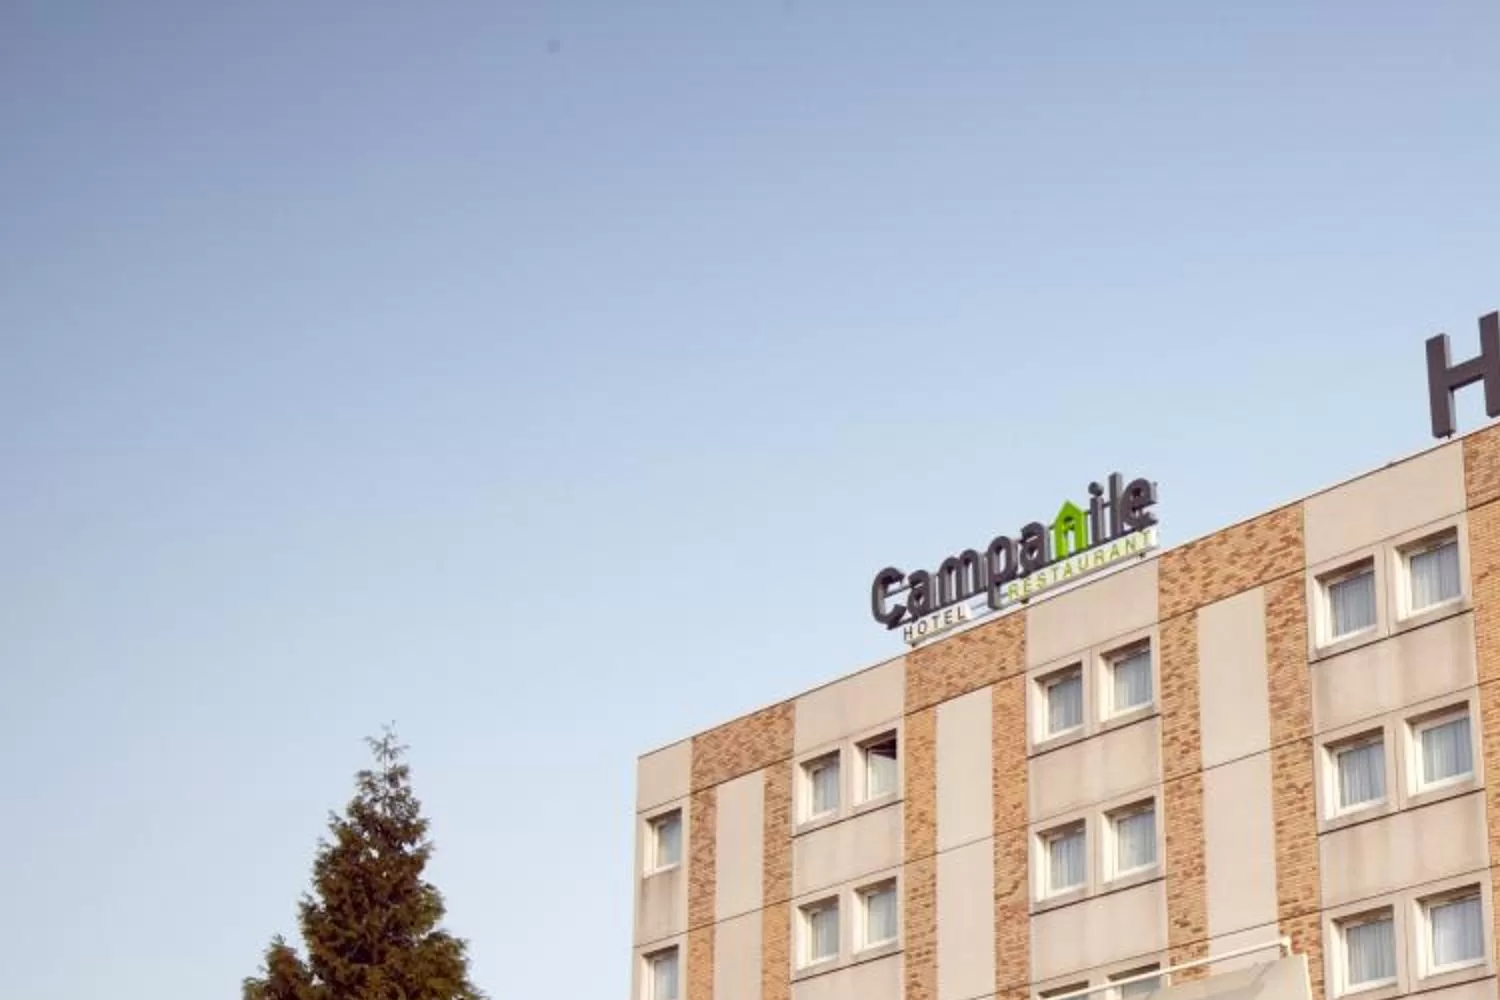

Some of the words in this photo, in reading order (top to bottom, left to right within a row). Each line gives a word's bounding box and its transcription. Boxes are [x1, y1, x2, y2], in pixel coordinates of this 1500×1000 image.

[871, 472, 1158, 629] Campanile
[903, 606, 966, 641] HOTEL
[1007, 530, 1154, 600] RESTAURANT
